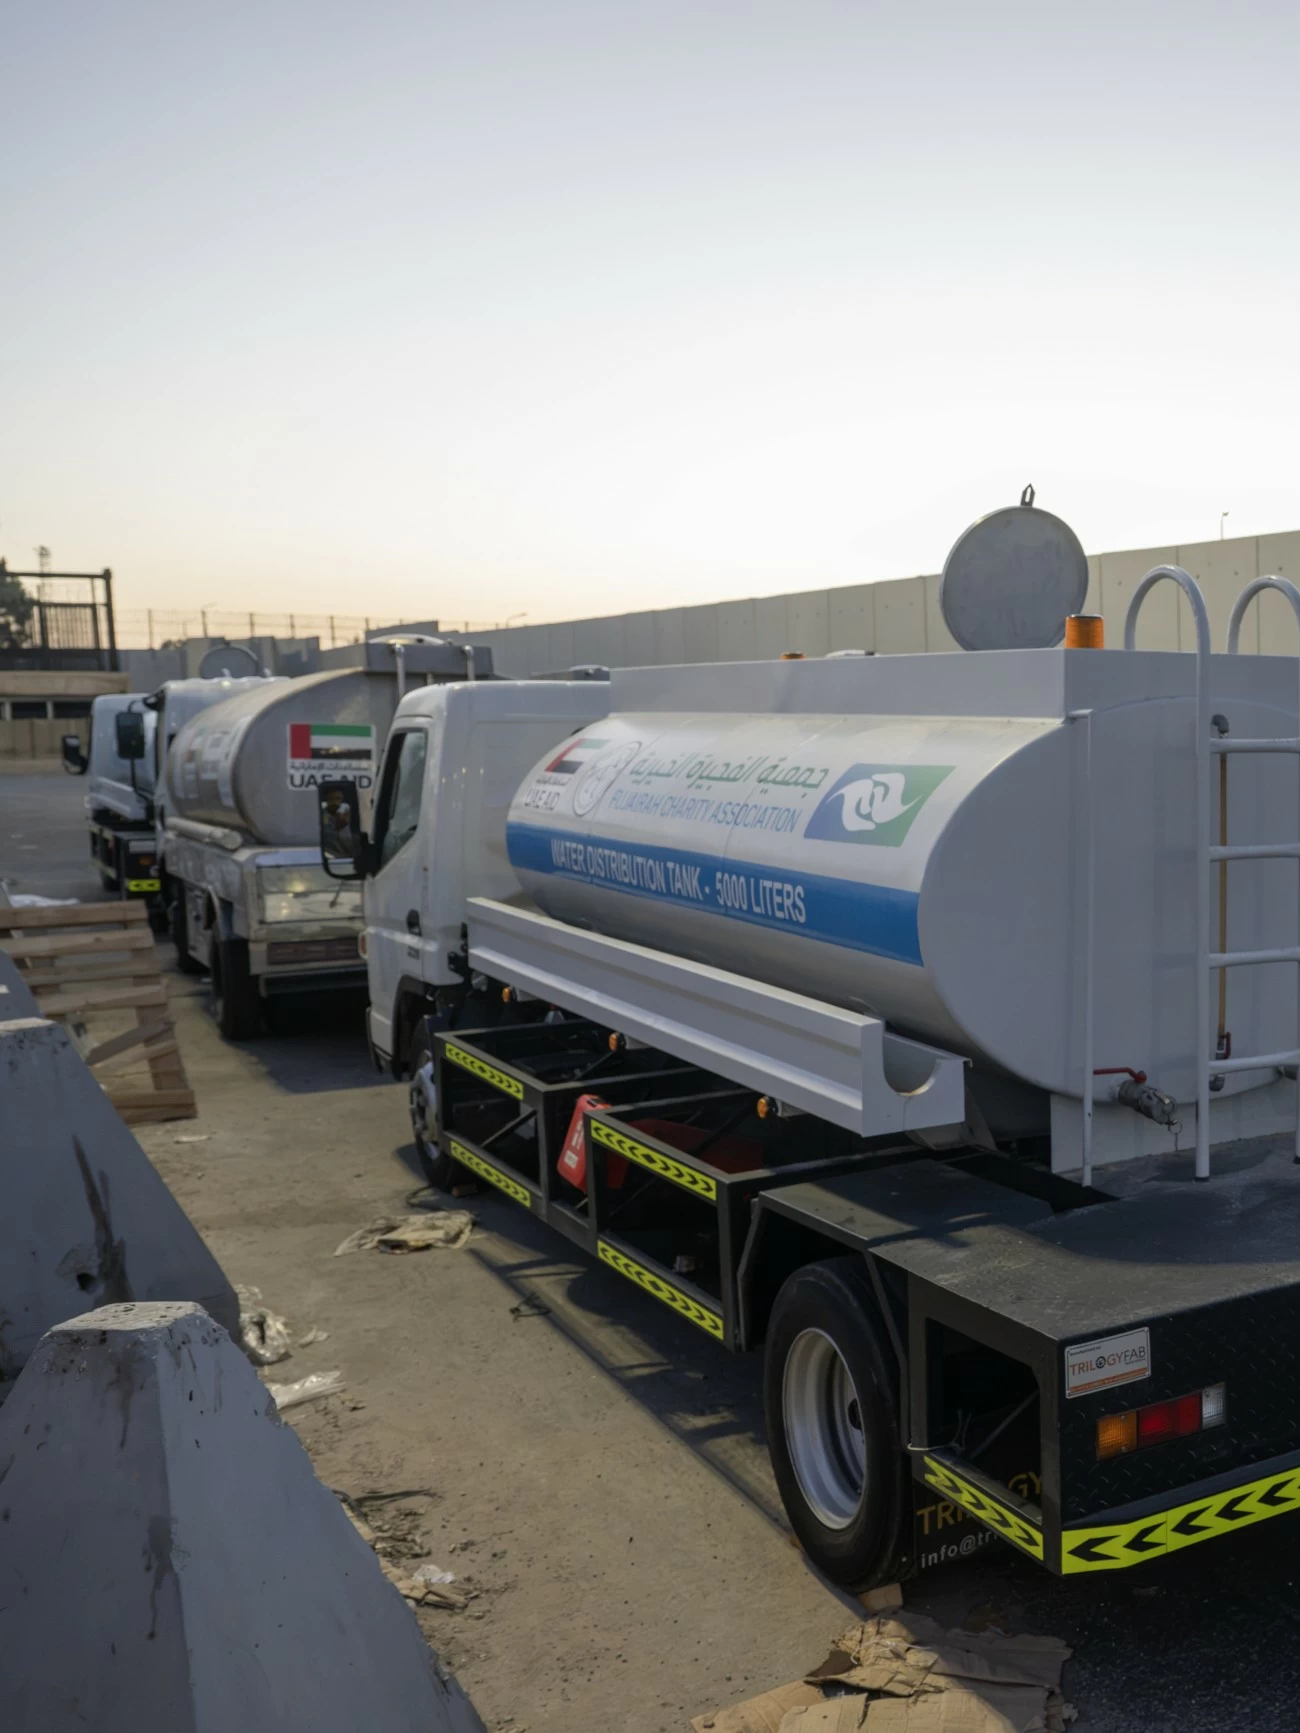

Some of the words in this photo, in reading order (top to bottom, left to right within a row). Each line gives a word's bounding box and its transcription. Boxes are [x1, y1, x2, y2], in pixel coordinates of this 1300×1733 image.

[686, 753, 770, 792] الفجيرة
[756, 756, 829, 799] جمعية
[608, 788, 666, 816] FUJAIRAH
[660, 794, 713, 822] CHARITY
[710, 801, 803, 833] ASSOCIATION
[551, 839, 585, 873] WATER
[586, 847, 667, 894] DISTRIBUTION
[667, 861, 704, 901] TANK
[715, 871, 748, 911] 5000
[750, 877, 807, 924] LITERS
[1069, 1346, 1146, 1376] TRILOGYFAB
